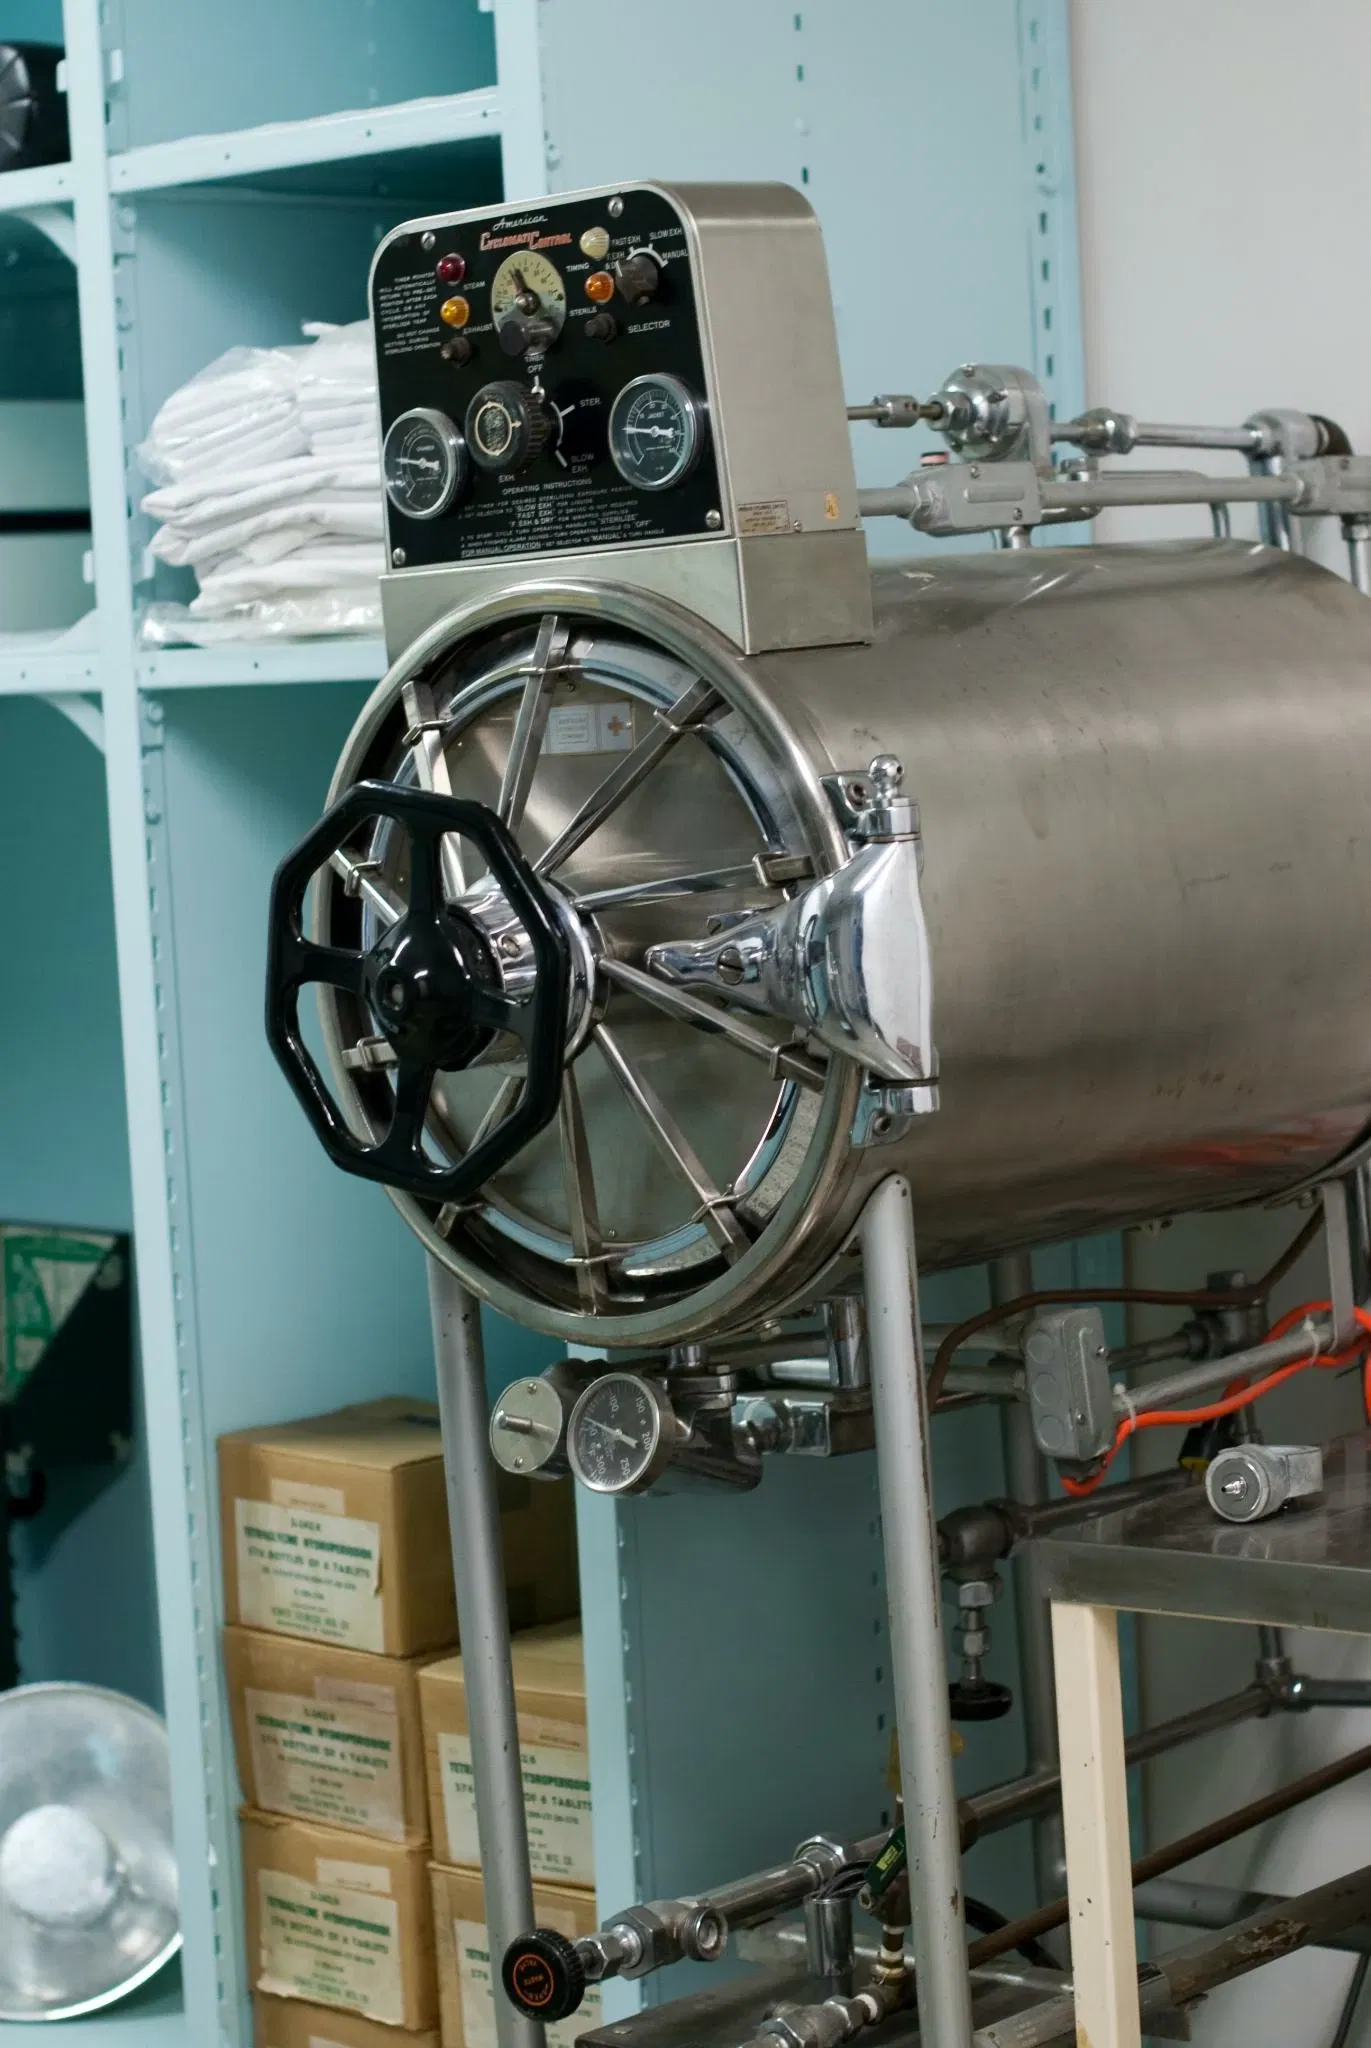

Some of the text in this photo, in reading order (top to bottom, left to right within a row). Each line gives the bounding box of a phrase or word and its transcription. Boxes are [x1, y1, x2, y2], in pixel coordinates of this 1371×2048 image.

[649, 228, 682, 240] SLOW EXH
[662, 249, 688, 260] MANUAL
[566, 262, 590, 272] TIMING
[464, 281, 486, 290] STEAM
[569, 306, 598, 316] STERILE
[463, 323, 493, 335] EXHAUST
[628, 320, 670, 334] SELECTOR
[527, 364, 543, 374] OFF
[502, 478, 592, 496] OPERATING INSTRUCTIONS
[502, 541, 541, 552] OPERATION
[635, 1396, 646, 1414] 150
[642, 1432, 652, 1450] 200
[620, 1458, 630, 1476] 250
[333, 1562, 370, 1578] TABLETS
[350, 1752, 388, 1770] TABLETS
[552, 1796, 592, 1812] TABLETS
